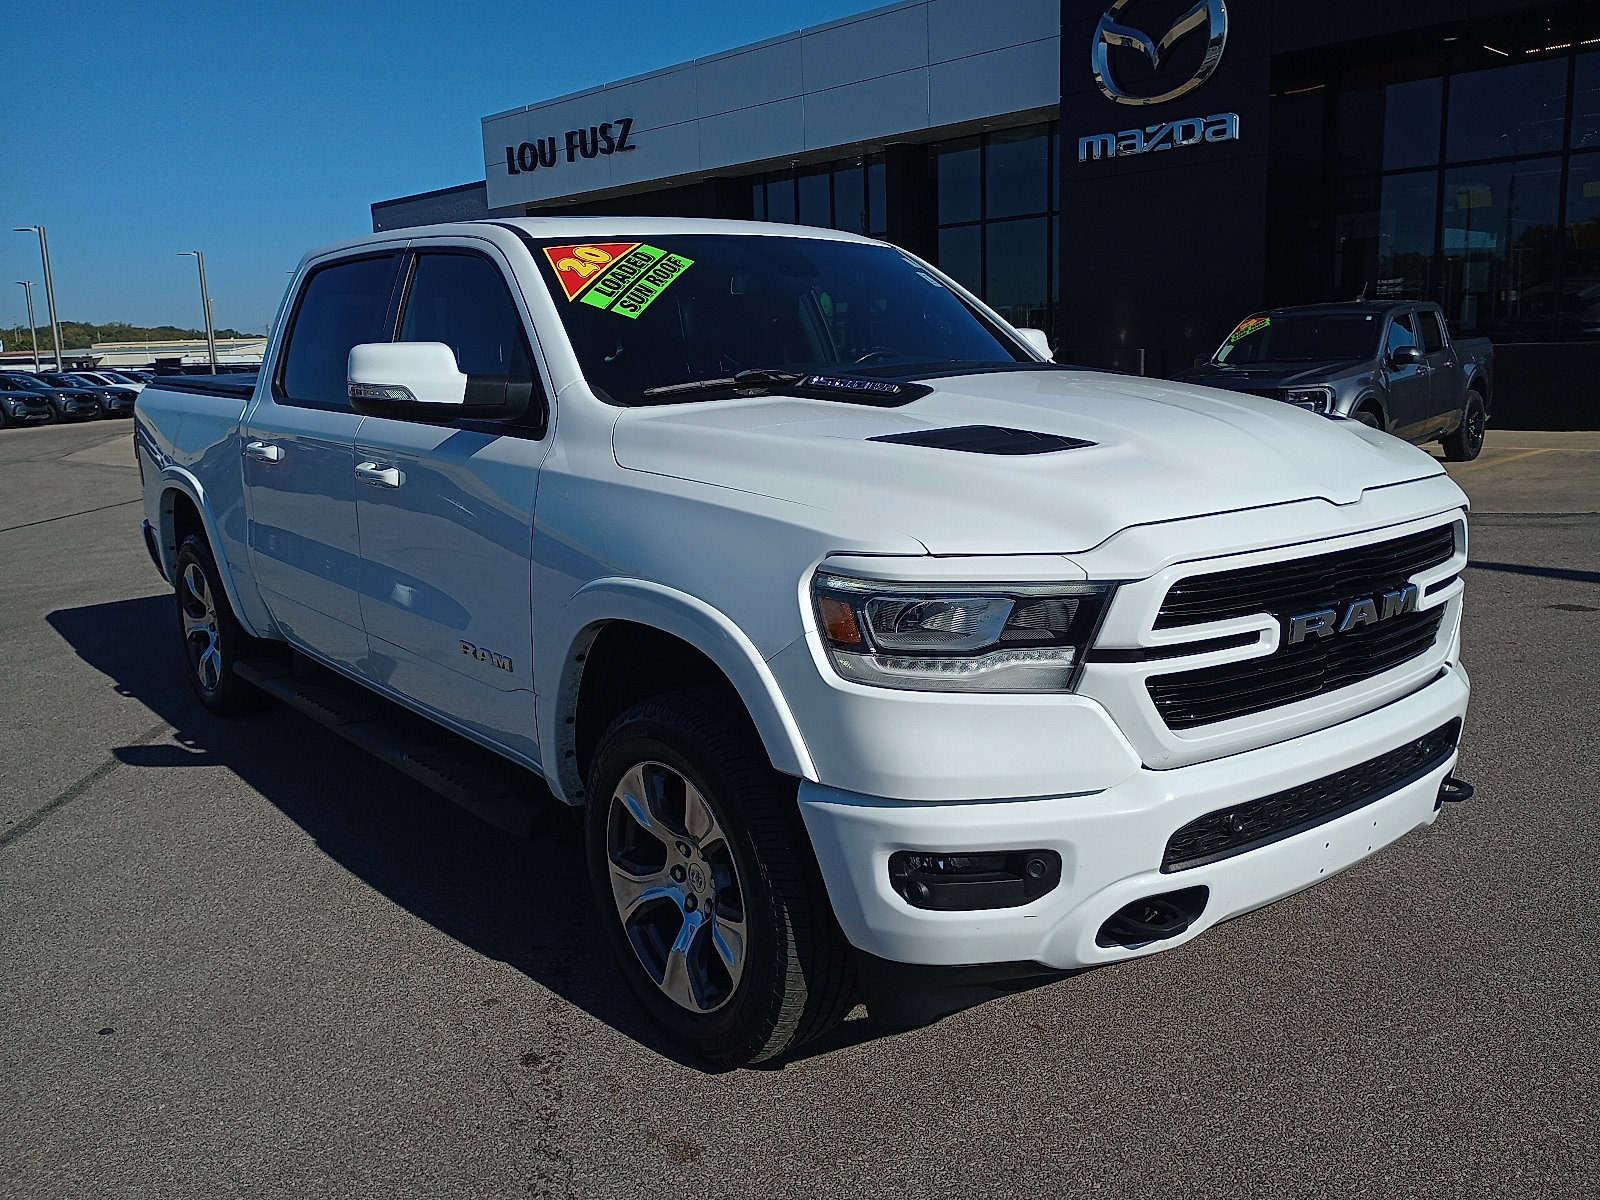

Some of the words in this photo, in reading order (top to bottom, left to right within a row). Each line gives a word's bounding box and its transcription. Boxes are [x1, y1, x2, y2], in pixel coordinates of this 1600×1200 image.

[505, 136, 557, 175] LOU
[564, 117, 637, 162] FUSZ
[556, 246, 613, 279] 20
[593, 252, 656, 298] LOADED
[619, 282, 658, 313] SUN
[643, 255, 686, 288] ROOF
[1288, 584, 1417, 644] RAM
[458, 639, 514, 673] RAM
